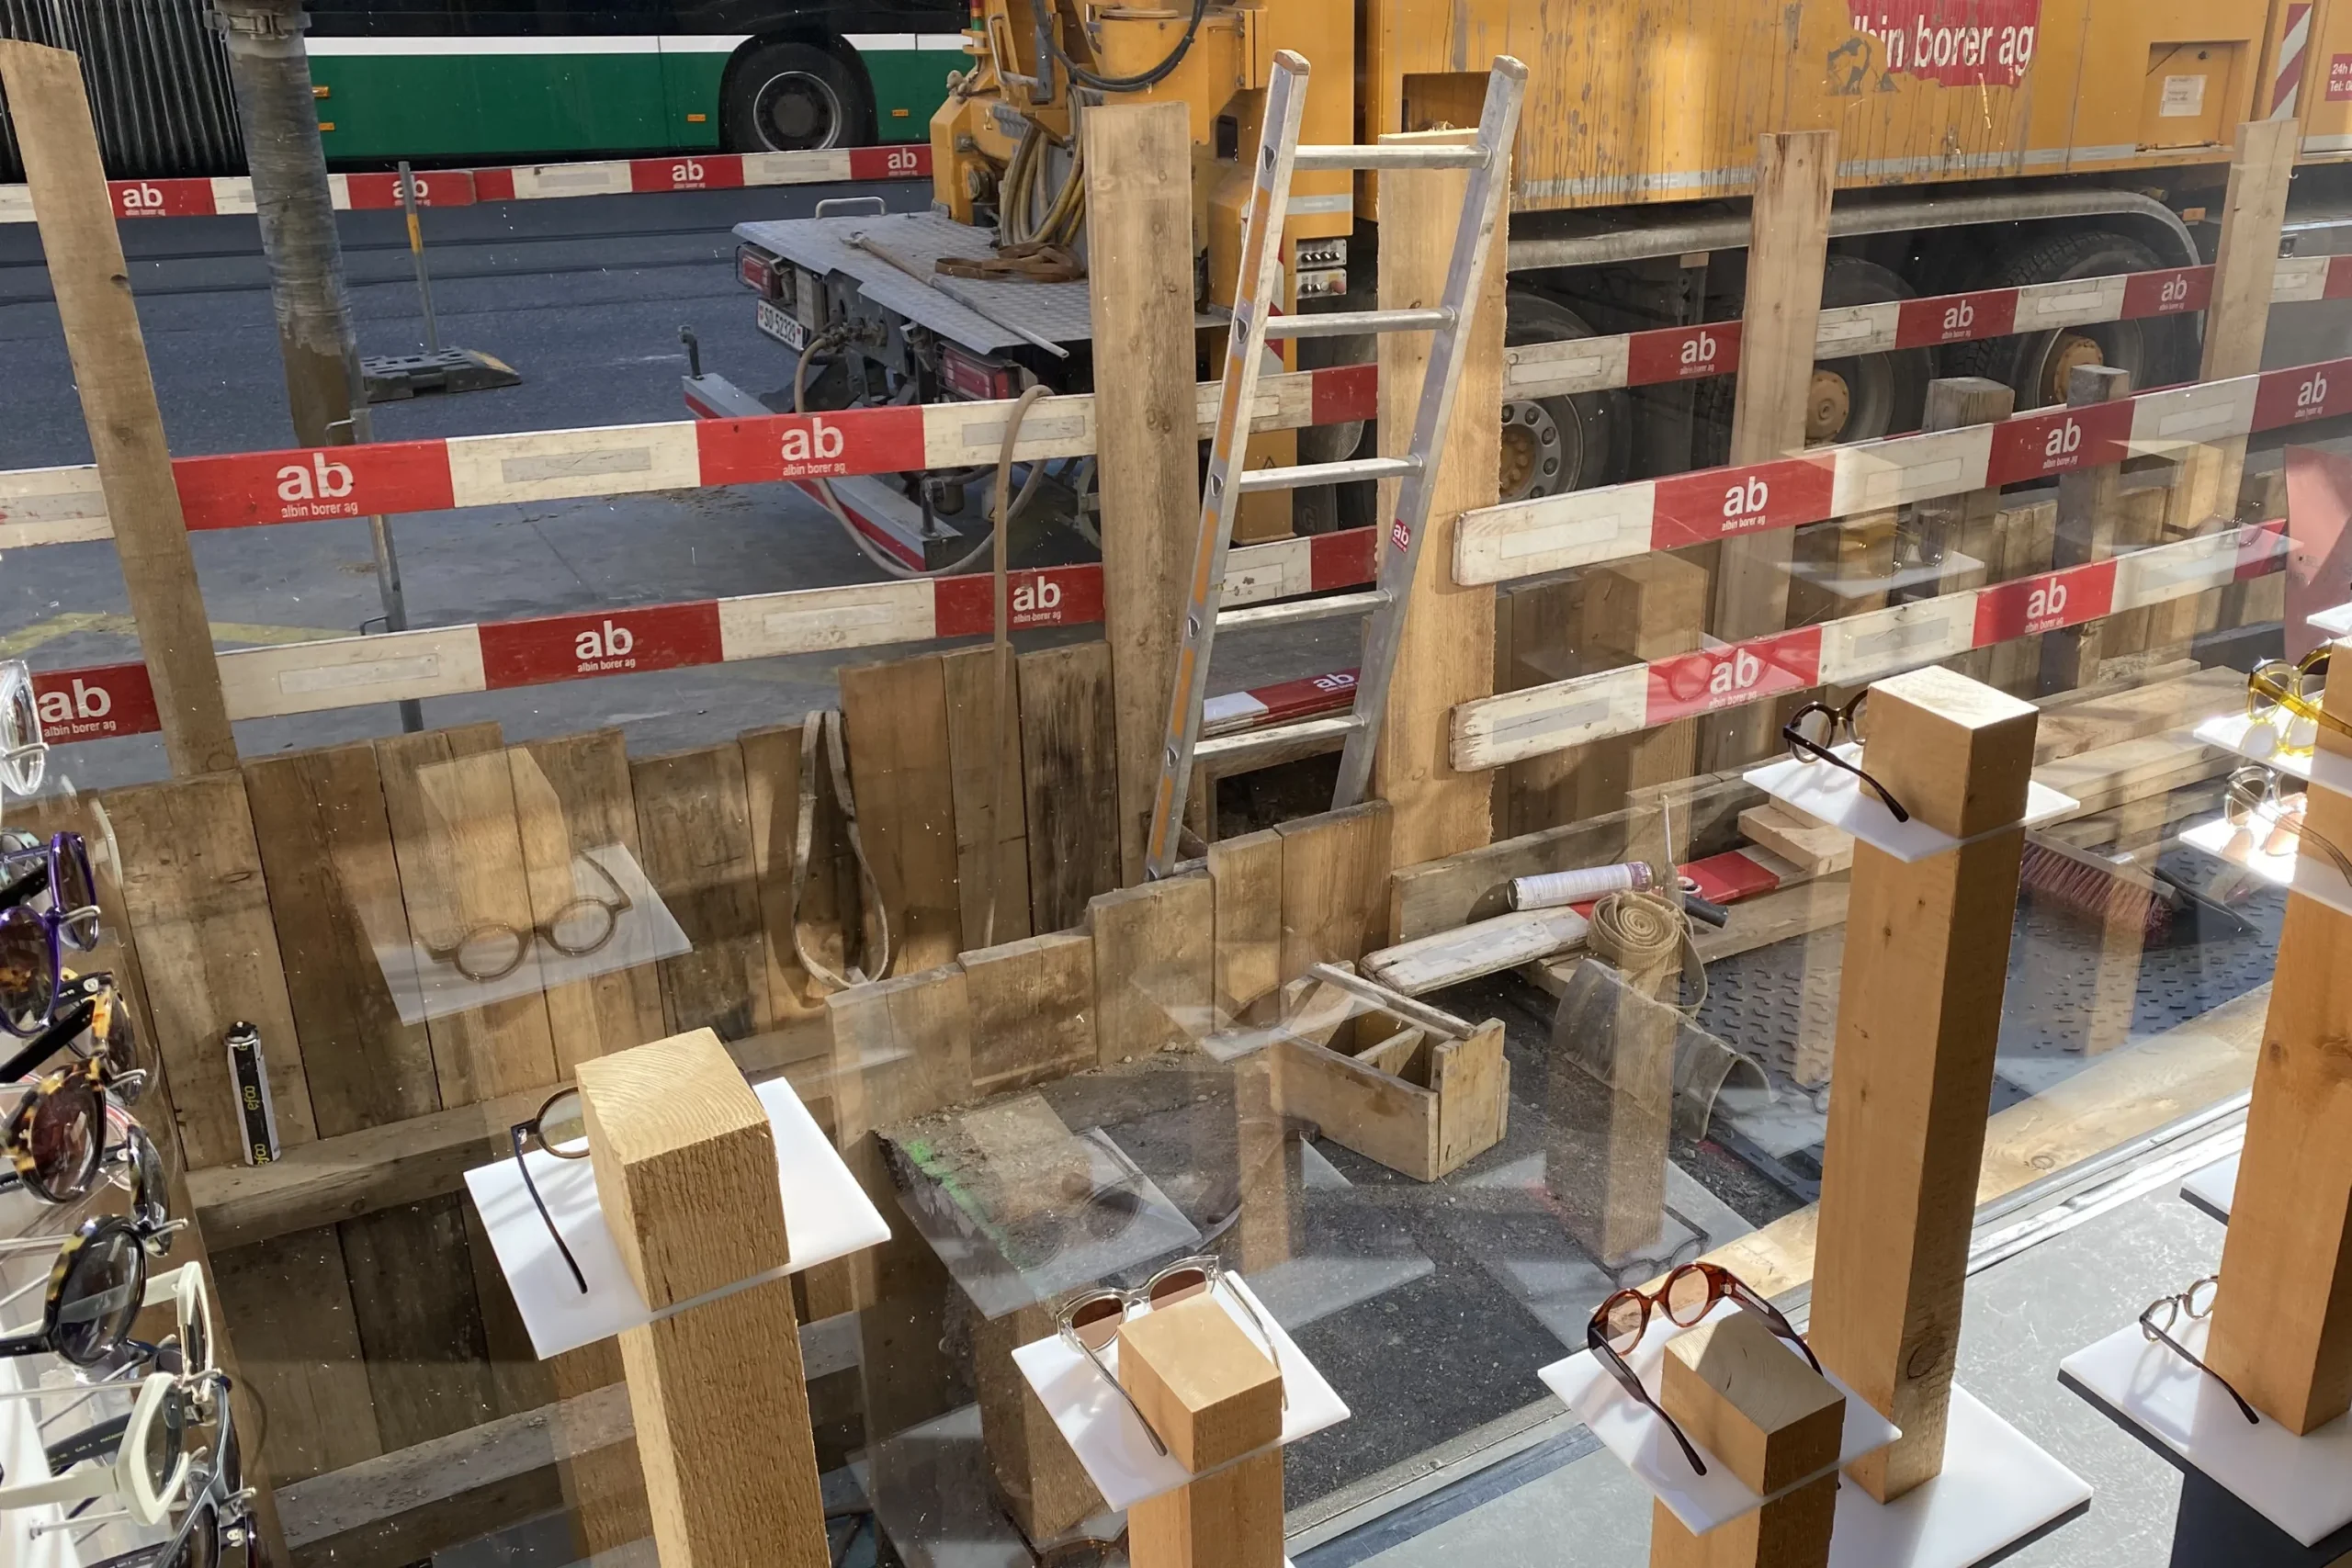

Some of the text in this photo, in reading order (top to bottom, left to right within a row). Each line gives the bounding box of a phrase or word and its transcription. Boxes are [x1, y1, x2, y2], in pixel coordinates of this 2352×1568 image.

[1914, 15, 1994, 67] borer
[2007, 25, 2035, 77] ag
[2332, 63, 2348, 75] 24h
[2330, 80, 2344, 92] Tel:
[673, 159, 704, 181] ab
[888, 147, 917, 169] ab
[122, 182, 164, 208] ab
[392, 175, 428, 198] ab
[2161, 274, 2188, 301] ab
[1943, 299, 1974, 329] ab
[1680, 331, 1716, 364] ab
[2297, 371, 2327, 407] ab
[781, 416, 844, 461] ab
[2045, 417, 2082, 456] ab
[277, 452, 354, 502] ab
[783, 462, 845, 477] albin borer ag
[1723, 476, 1769, 517] ab
[281, 502, 358, 518] albin borer ag
[1394, 524, 1409, 546] ab
[1721, 515, 1766, 532] albin borer ag
[1012, 575, 1061, 612] ab
[2026, 577, 2067, 619] ab
[1052, 611, 1061, 620] ag
[575, 619, 633, 660] ab
[577, 659, 636, 672] albin borer ag
[1710, 648, 1759, 695] ab
[1313, 673, 1355, 689] ab
[38, 678, 111, 723] ab
[43, 720, 117, 737] albin borer ag
[244, 1086, 260, 1110] efco
